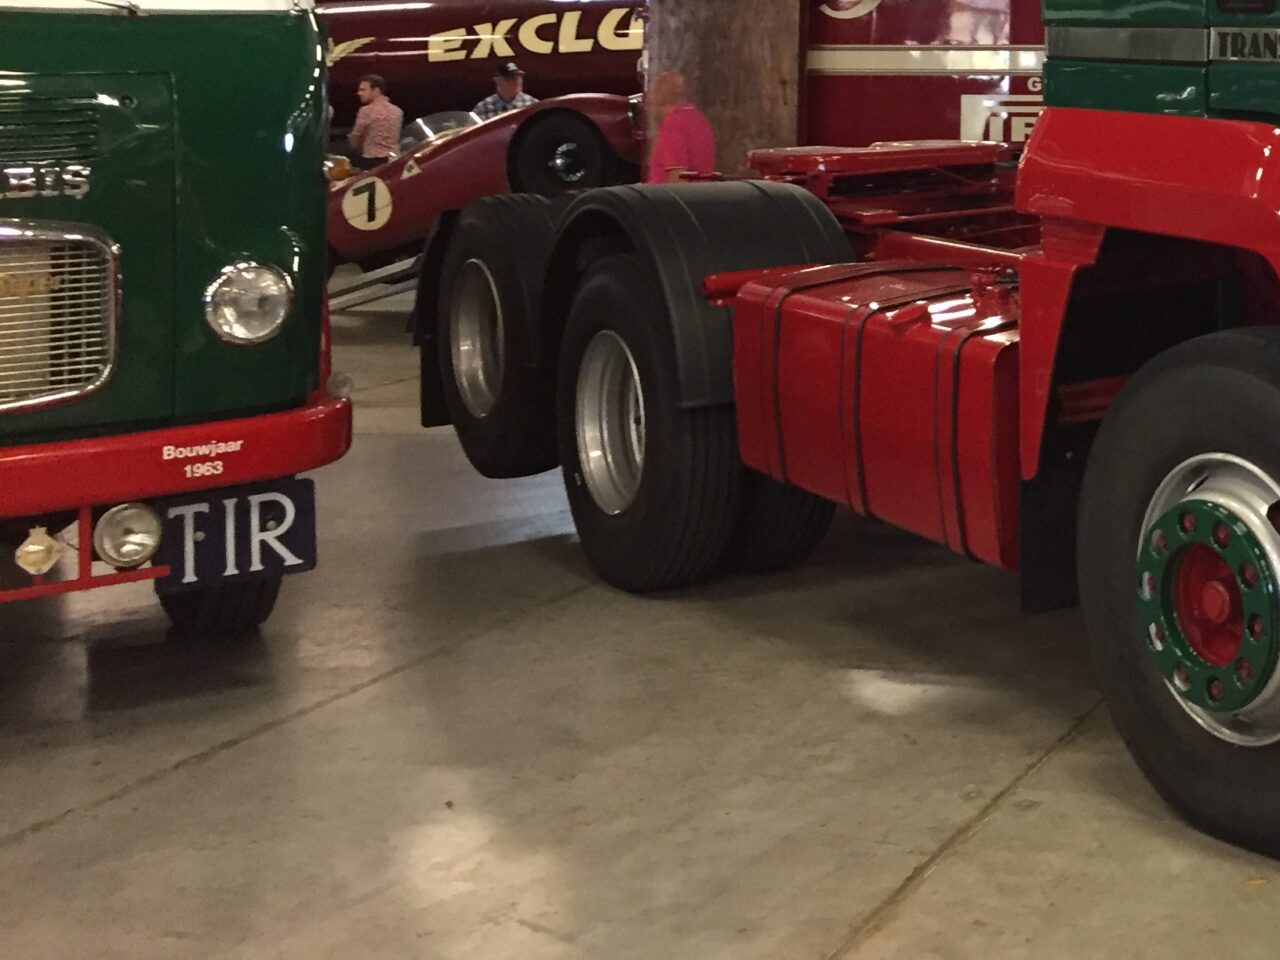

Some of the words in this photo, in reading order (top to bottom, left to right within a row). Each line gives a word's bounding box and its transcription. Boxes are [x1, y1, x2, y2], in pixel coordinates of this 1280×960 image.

[353, 181, 377, 223] 7
[162, 440, 244, 460] Bouwjaar
[184, 461, 224, 478] 1963
[167, 492, 304, 583] TIR
